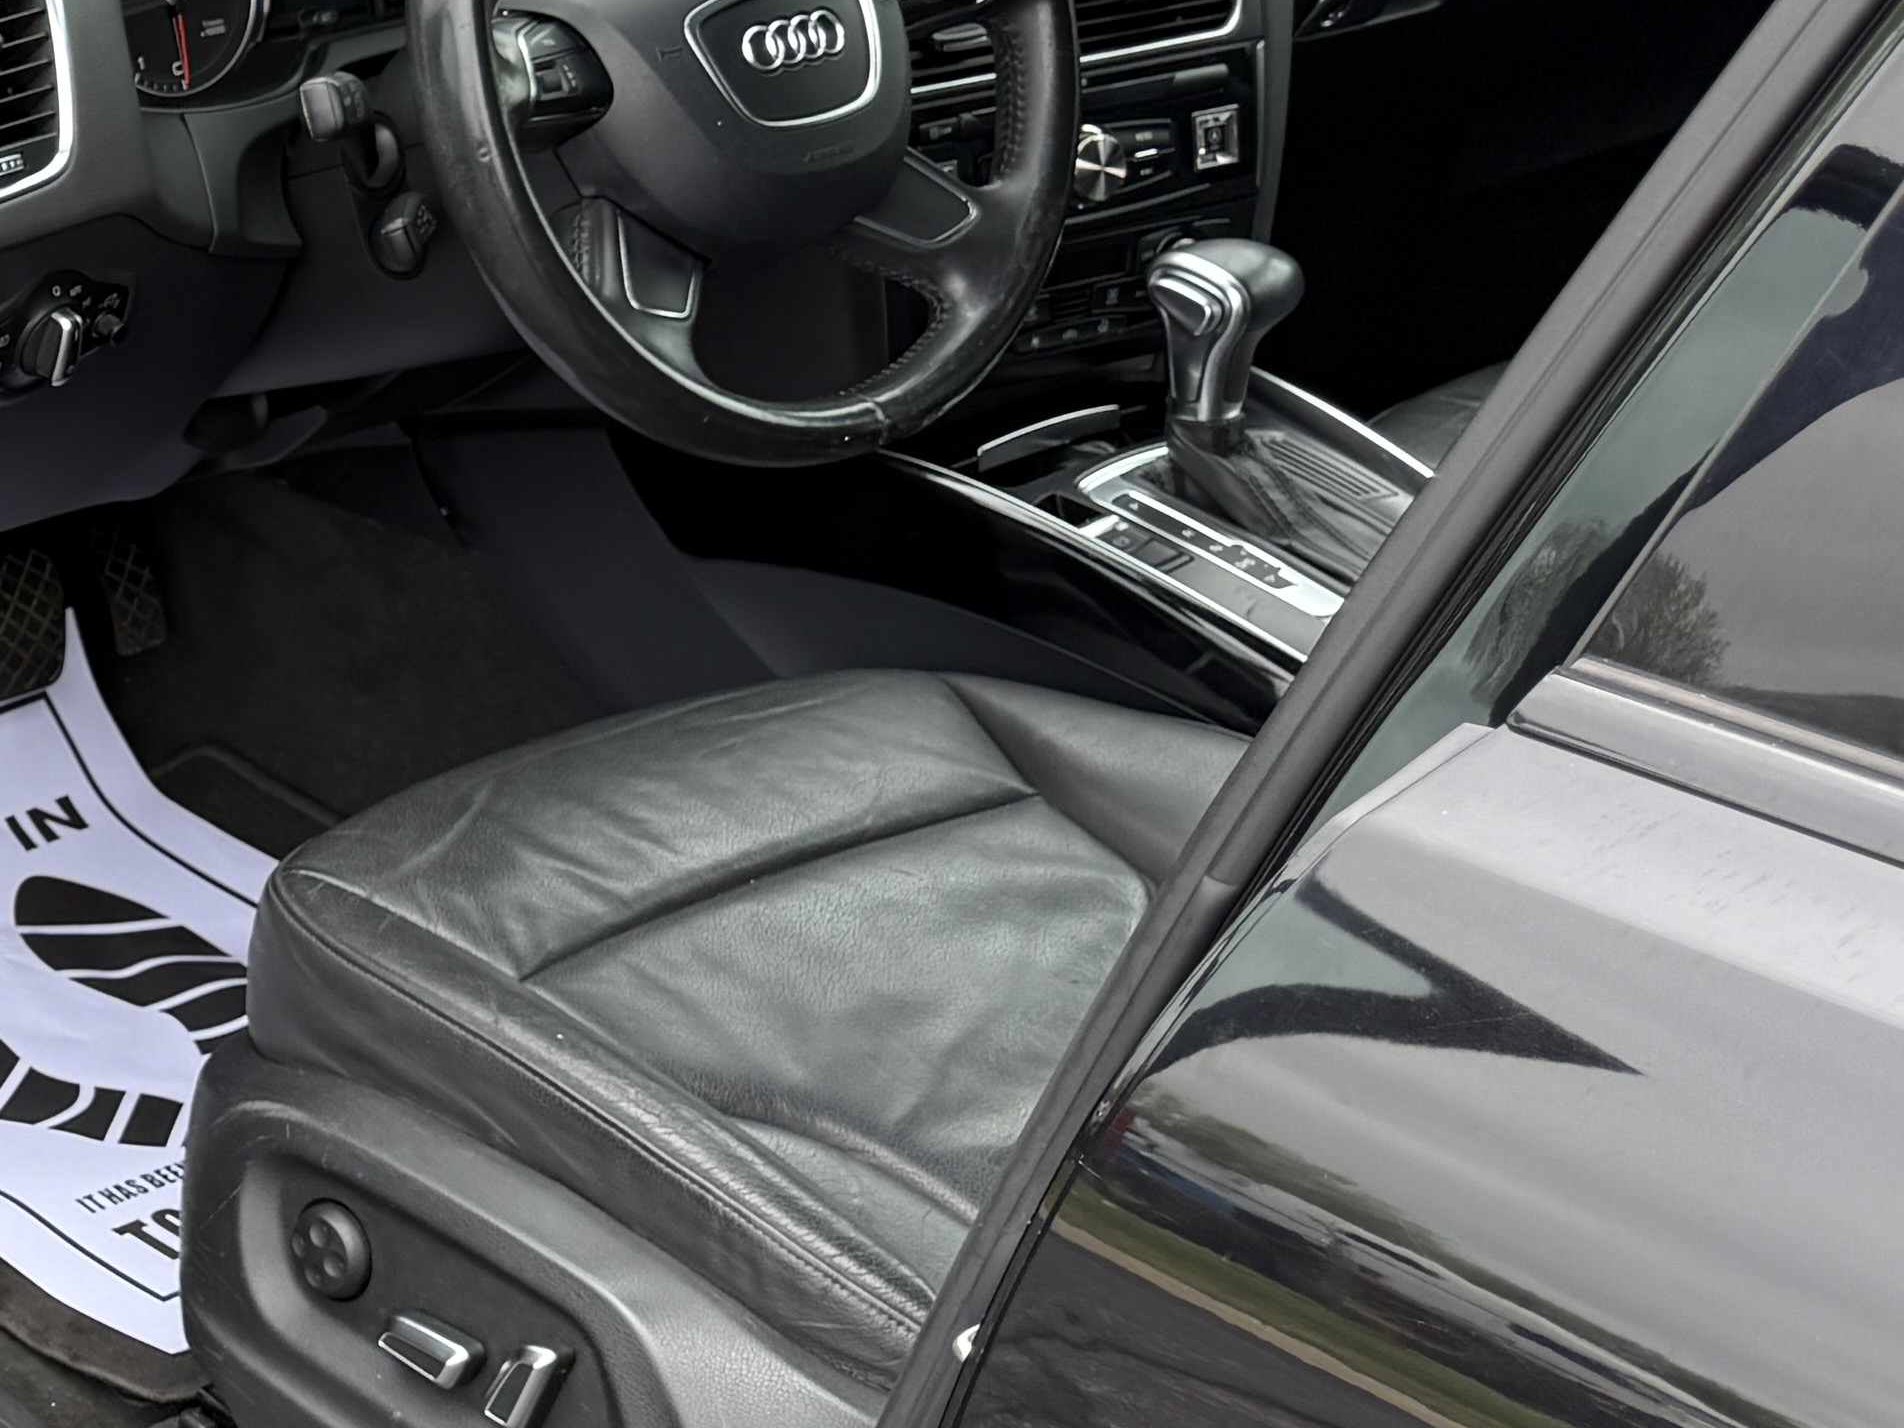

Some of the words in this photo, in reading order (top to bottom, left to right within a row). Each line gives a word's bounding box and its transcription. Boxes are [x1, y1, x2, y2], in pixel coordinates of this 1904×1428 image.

[4, 794, 90, 852] IN
[74, 1194, 106, 1214] IT
[97, 1179, 149, 1205] HAS
